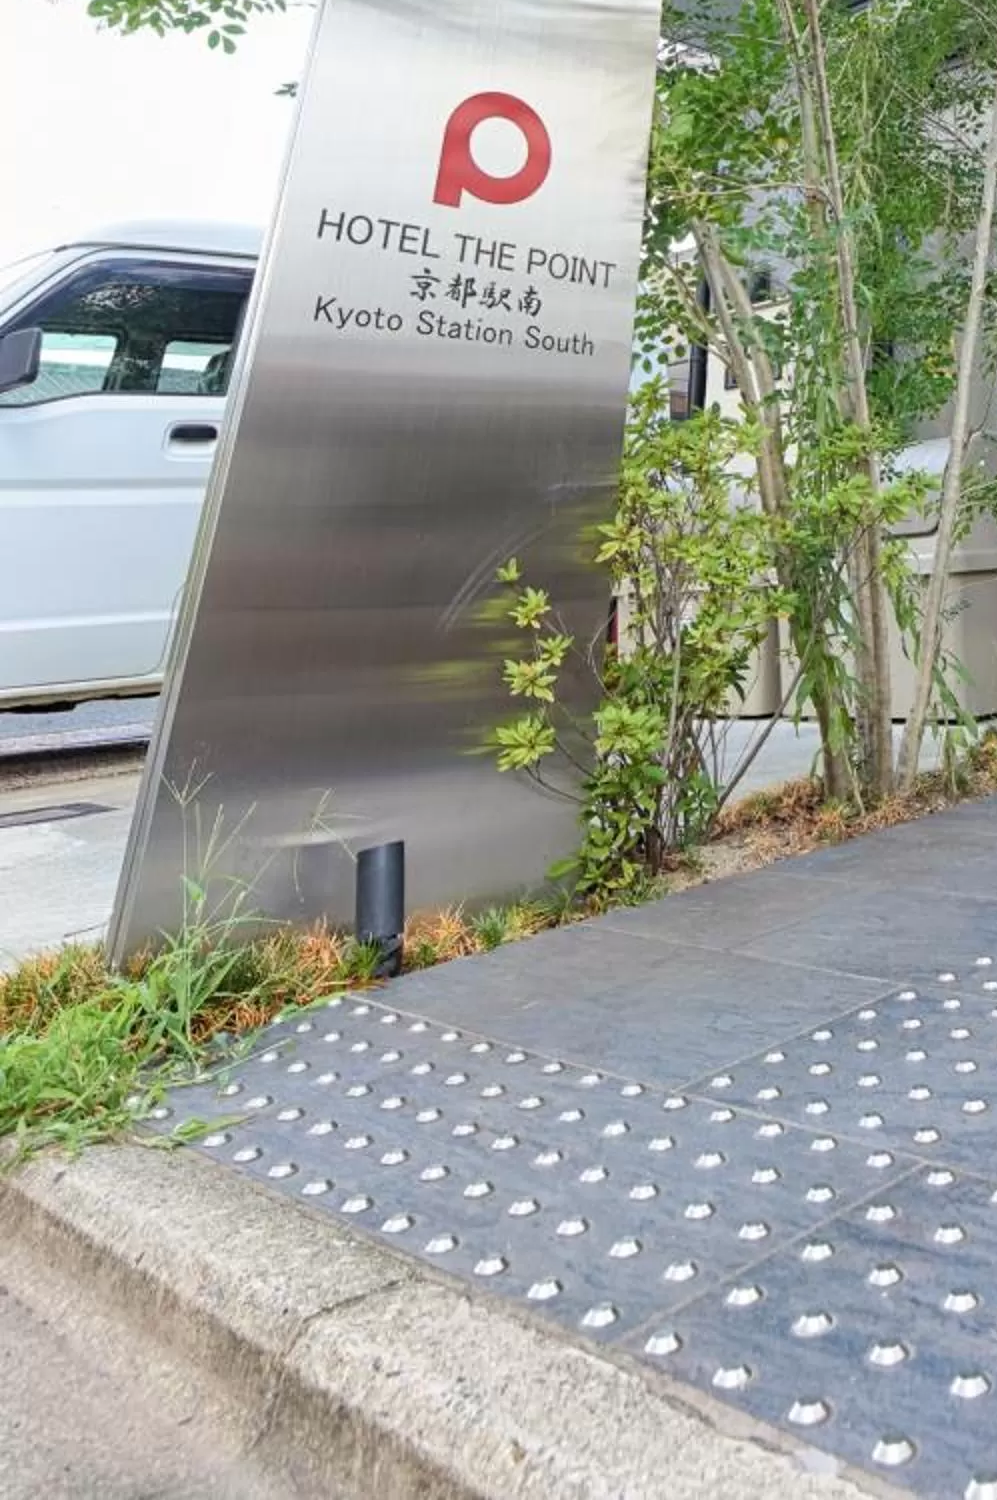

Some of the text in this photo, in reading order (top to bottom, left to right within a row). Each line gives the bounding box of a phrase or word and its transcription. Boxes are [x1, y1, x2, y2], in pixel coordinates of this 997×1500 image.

[316, 207, 617, 289] HOTEL THE POINT
[409, 267, 542, 317] 京都駅南
[313, 295, 595, 356] Kyoto Station South
